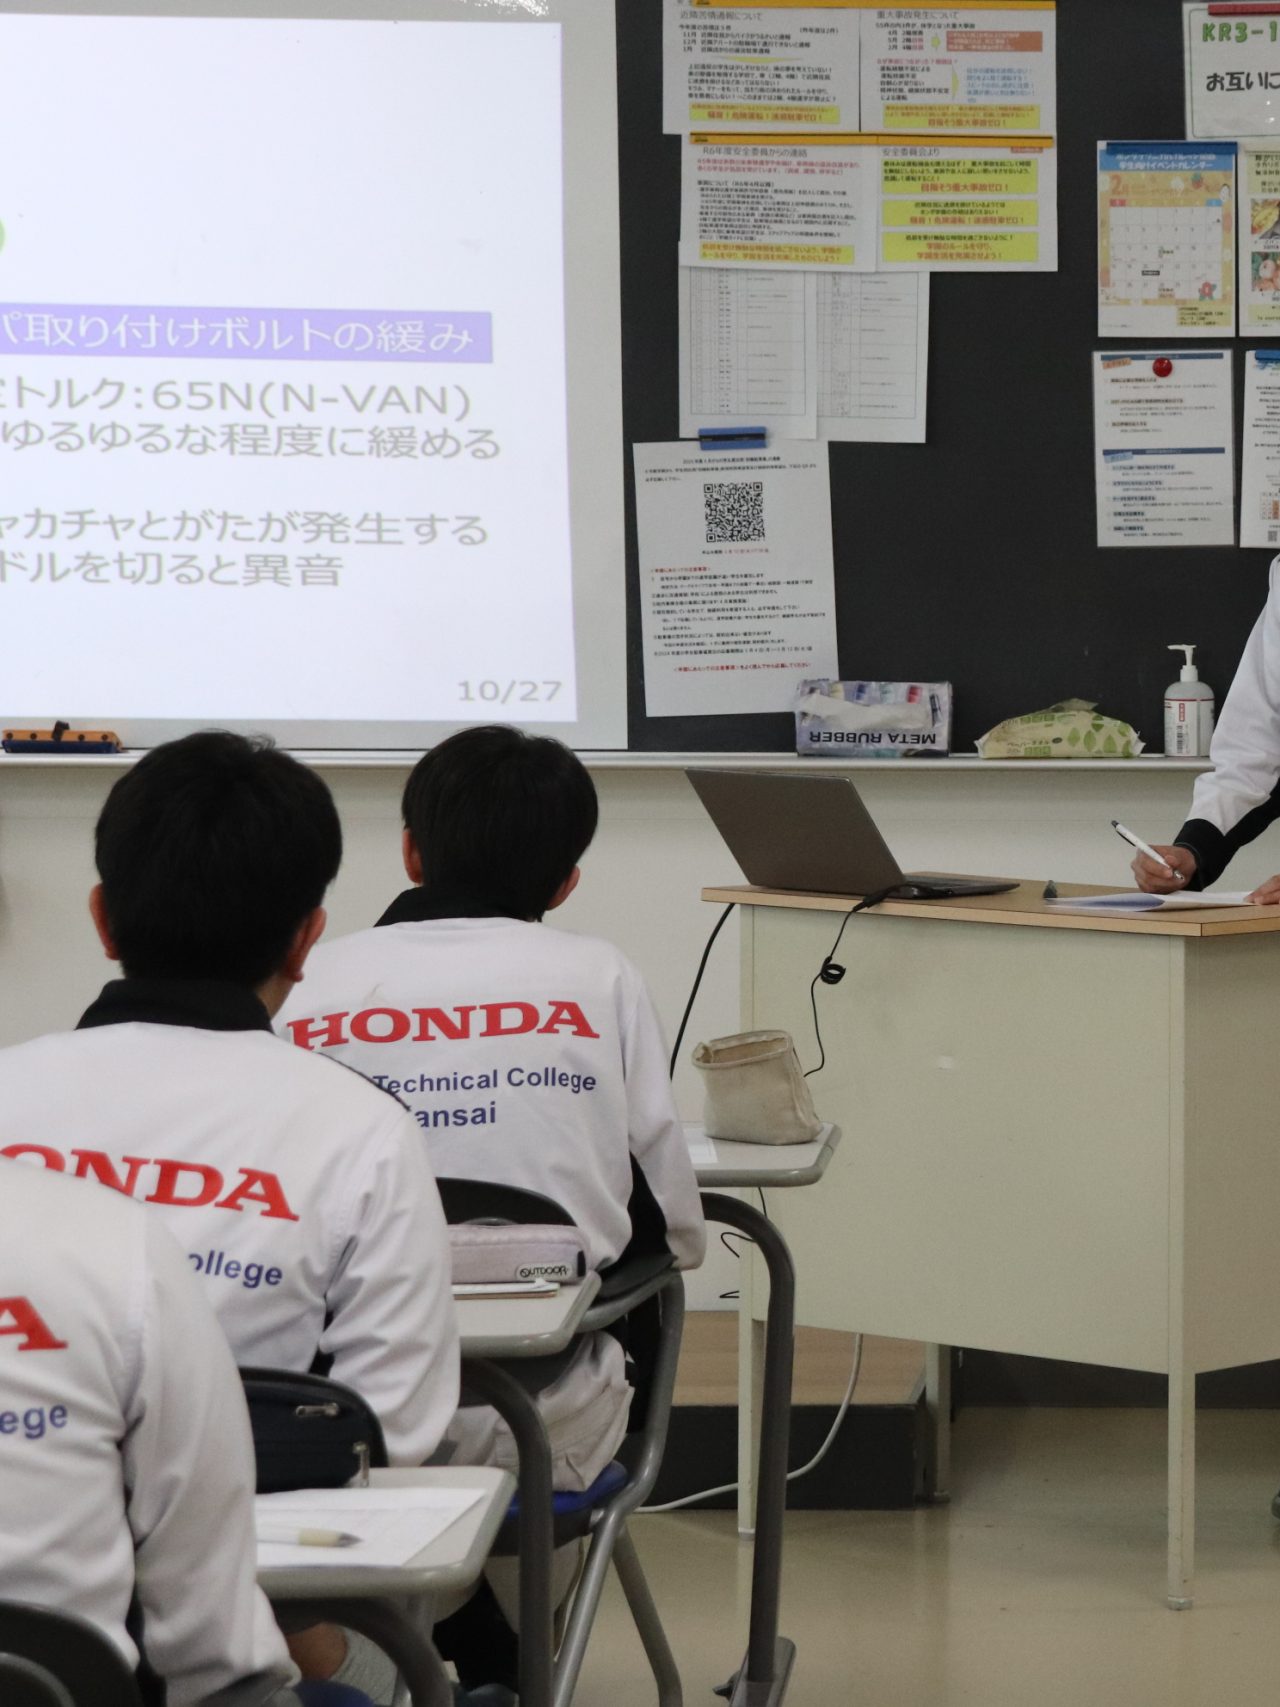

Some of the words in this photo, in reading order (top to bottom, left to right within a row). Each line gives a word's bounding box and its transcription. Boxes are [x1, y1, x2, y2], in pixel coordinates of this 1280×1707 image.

[0, 376, 471, 421] トルク:65N(N-VAN)
[1, 422, 500, 460] ゆるゆるな程度に緩める
[0, 551, 344, 588] ドルを切ると異音
[457, 680, 562, 704] 10/27
[809, 731, 882, 744] RUBBER
[888, 732, 936, 745] META
[286, 1000, 601, 1051] HONDA
[372, 1069, 498, 1095] Technical
[507, 1066, 597, 1094] College
[414, 1100, 497, 1128] ansai
[188, 1249, 283, 1289] ollege
